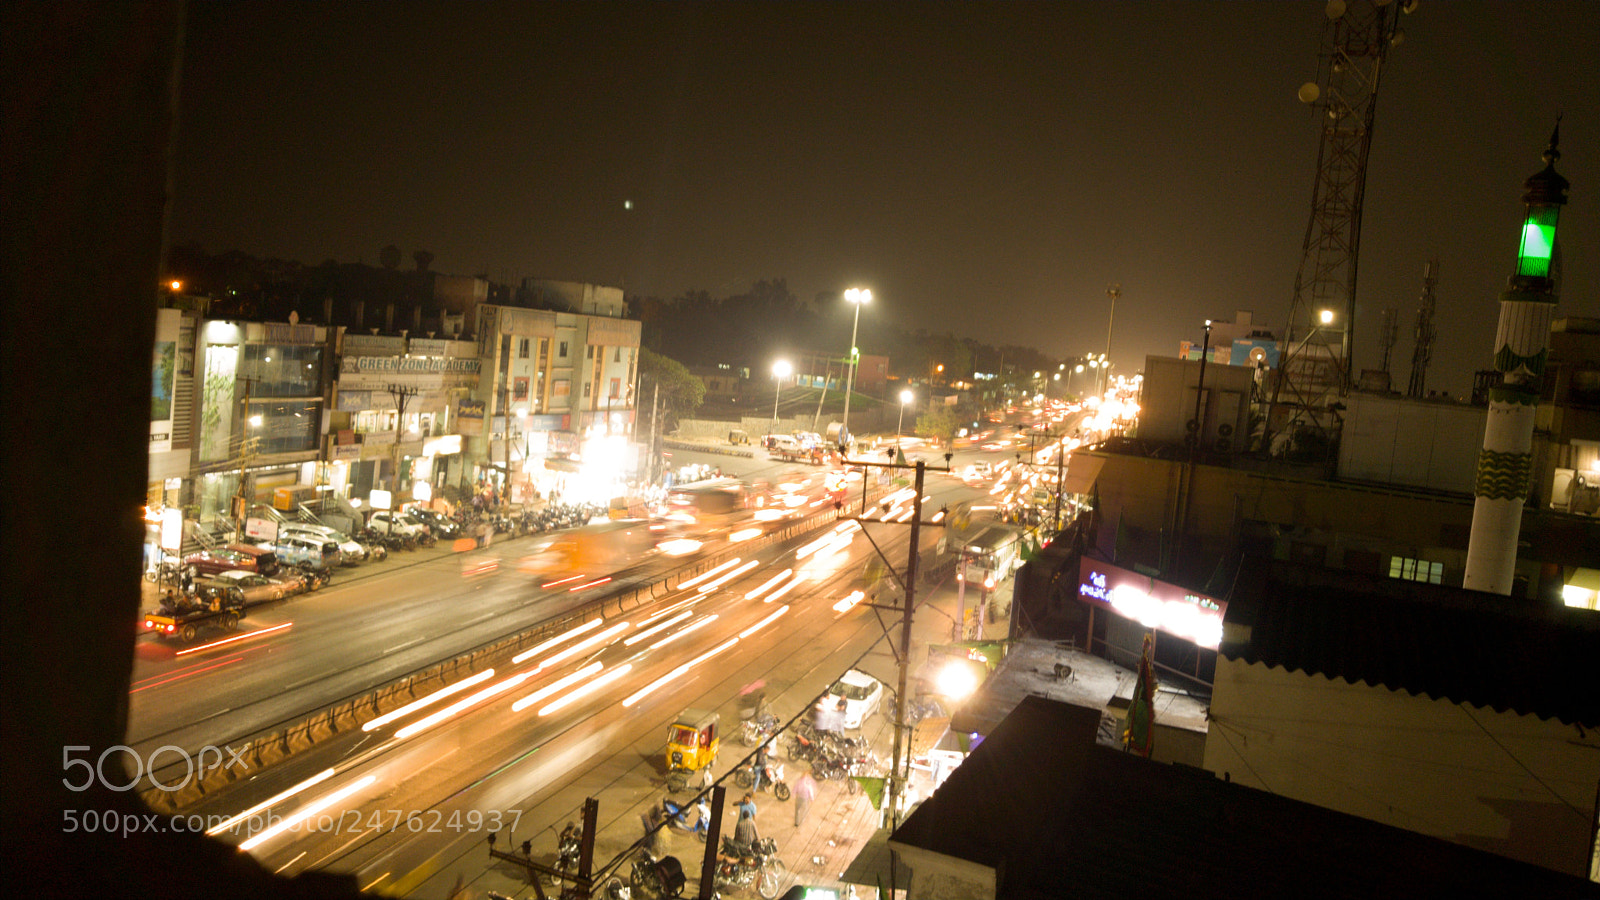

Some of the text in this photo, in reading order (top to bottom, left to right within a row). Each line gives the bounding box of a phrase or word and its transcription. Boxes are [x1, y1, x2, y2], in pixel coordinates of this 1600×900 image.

[359, 357, 480, 371] GREEN ZONE ACADEMY
